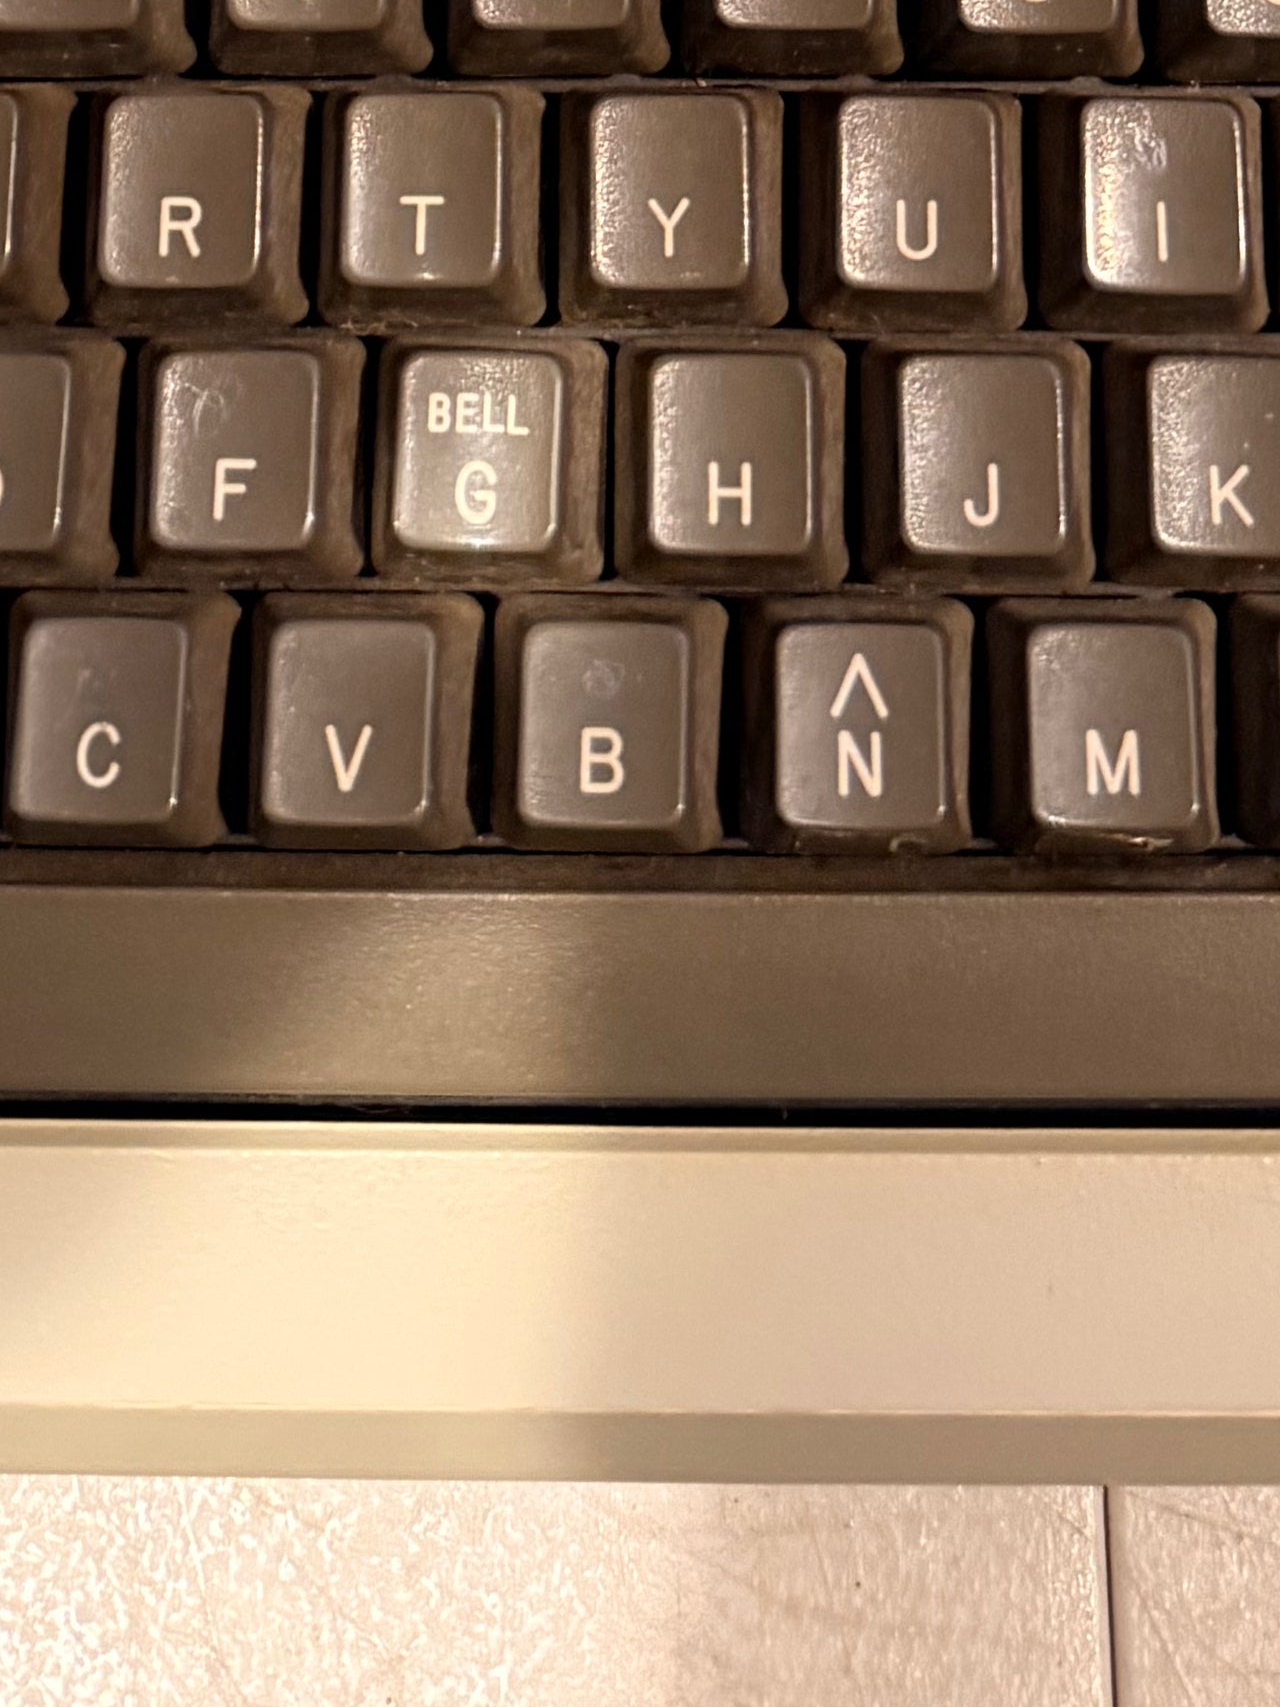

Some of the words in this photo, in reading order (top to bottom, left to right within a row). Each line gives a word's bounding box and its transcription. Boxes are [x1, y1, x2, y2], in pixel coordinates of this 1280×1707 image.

[158, 196, 203, 258] R
[399, 195, 446, 257] T
[647, 197, 692, 259] Y
[896, 199, 939, 261] U
[1156, 201, 1169, 262] I
[427, 392, 530, 437] BELL
[213, 458, 258, 522] F
[454, 460, 499, 526] G
[707, 461, 754, 528] H
[963, 462, 1000, 528] J
[1209, 463, 1255, 528] K
[76, 721, 121, 789] C
[325, 723, 374, 792] V
[579, 725, 625, 794] B
[838, 729, 884, 797] N
[1085, 729, 1140, 797] M
